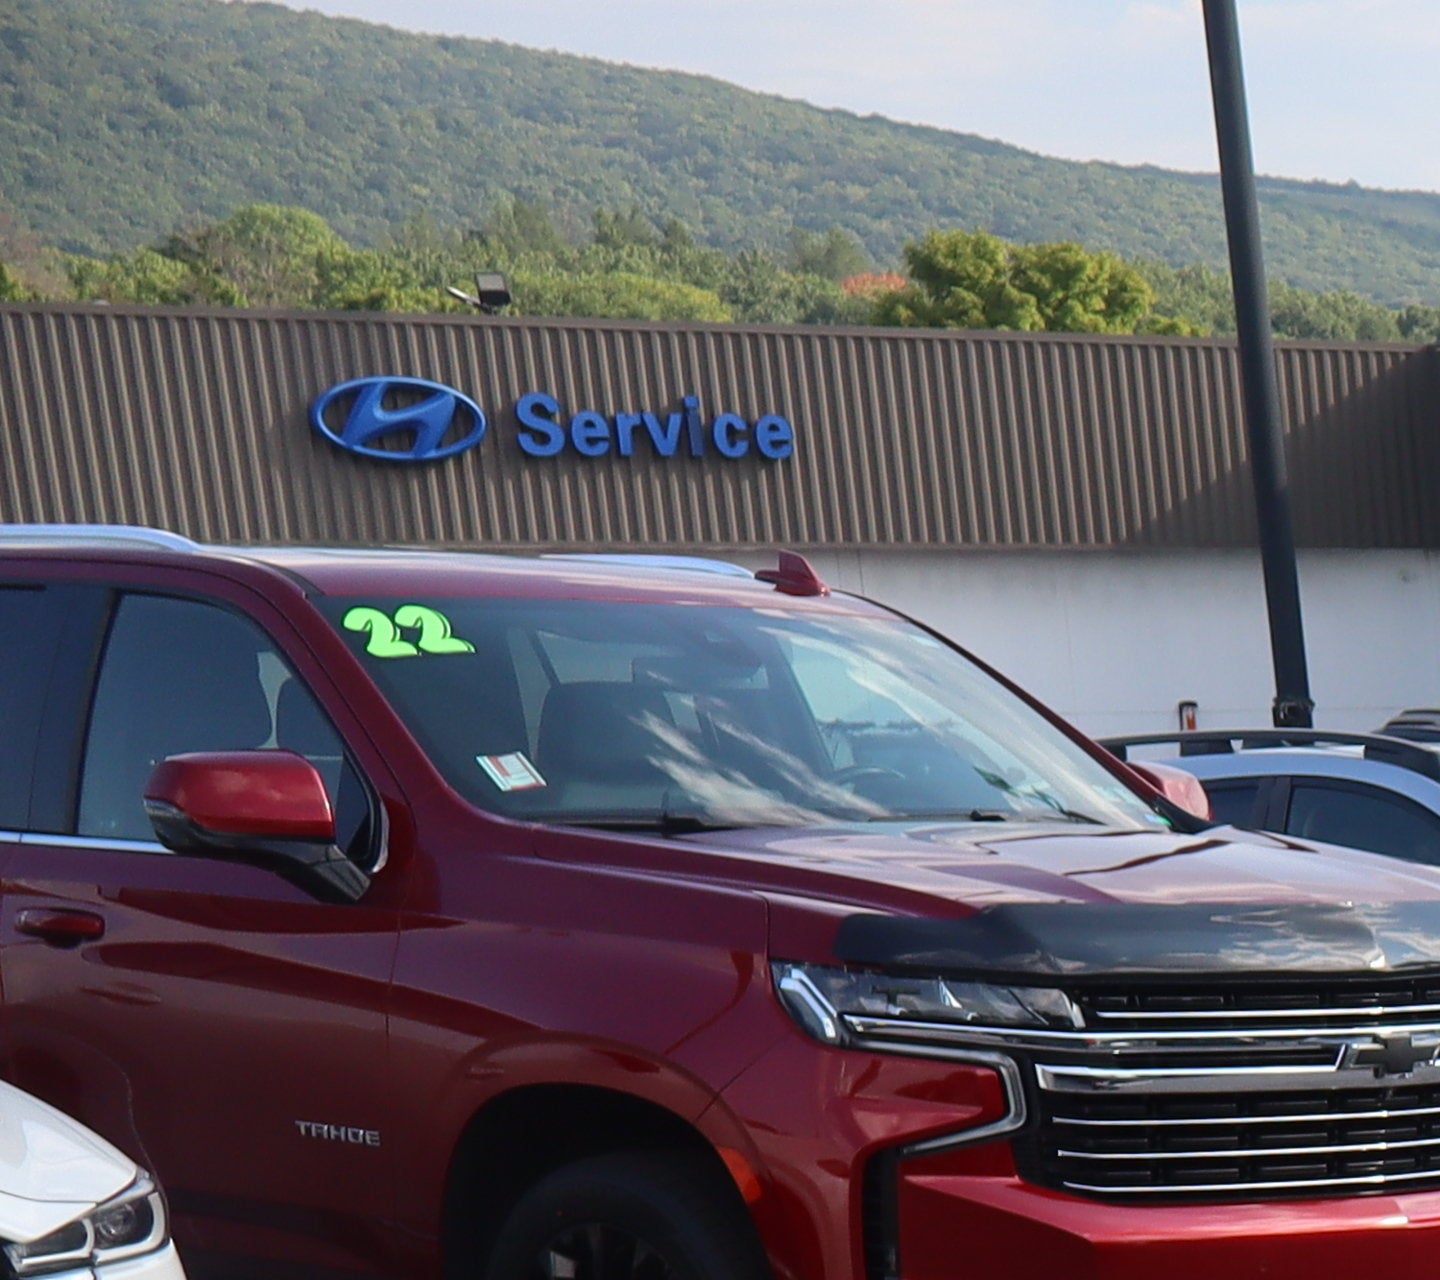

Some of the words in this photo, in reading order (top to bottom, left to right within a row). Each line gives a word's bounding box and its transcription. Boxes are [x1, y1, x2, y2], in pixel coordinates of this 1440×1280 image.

[515, 391, 794, 459] Service
[342, 604, 476, 659] 22
[294, 1120, 381, 1147] TAHOE
